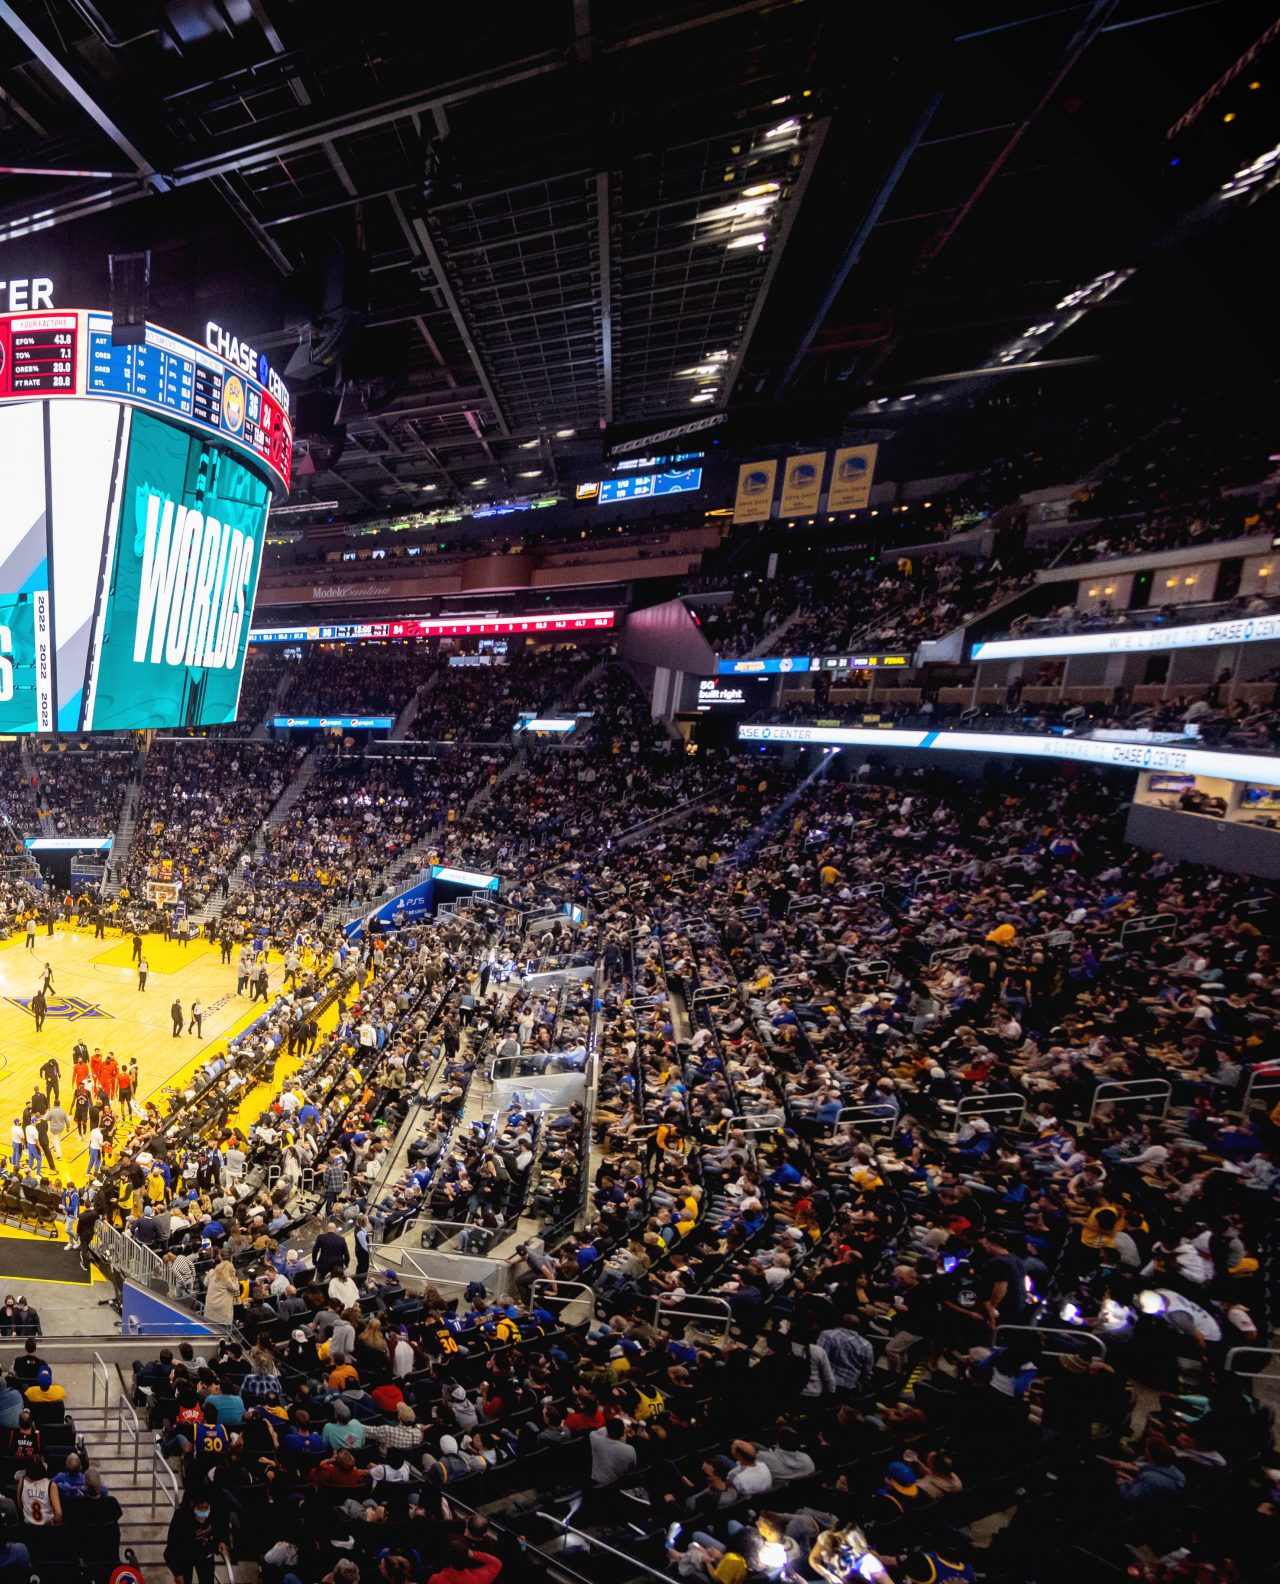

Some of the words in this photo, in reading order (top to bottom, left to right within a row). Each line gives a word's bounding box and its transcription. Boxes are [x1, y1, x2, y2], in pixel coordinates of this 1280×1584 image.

[54, 334, 71, 344] 43.8
[60, 348, 71, 358] 7.1
[206, 321, 258, 378] CHASE
[95, 352, 111, 360] OREB
[126, 354, 132, 365] 2
[15, 365, 39, 373] OREB%
[53, 362, 71, 372] 20.0
[53, 376, 71, 386] 20.8
[249, 392, 259, 420] 36
[263, 404, 272, 430] 24
[133, 494, 255, 670] WORLDS
[313, 587, 345, 599] Modelo
[344, 585, 391, 597] Cantina
[393, 626, 403, 634] 24
[1207, 624, 1244, 641] CHASE
[699, 690, 719, 699] built
[720, 689, 743, 700] right
[41, 693, 49, 726] 2022
[774, 729, 811, 739] CENTER
[1112, 747, 1143, 763] CHASE
[1153, 751, 1187, 768] CENTER
[406, 897, 425, 906] PS5
[454, 1321, 462, 1331] 11
[440, 1337, 459, 1354] 30
[204, 1437, 223, 1452] 30
[27, 1488, 45, 1500] ELLIS
[31, 1499, 43, 1522] 8
